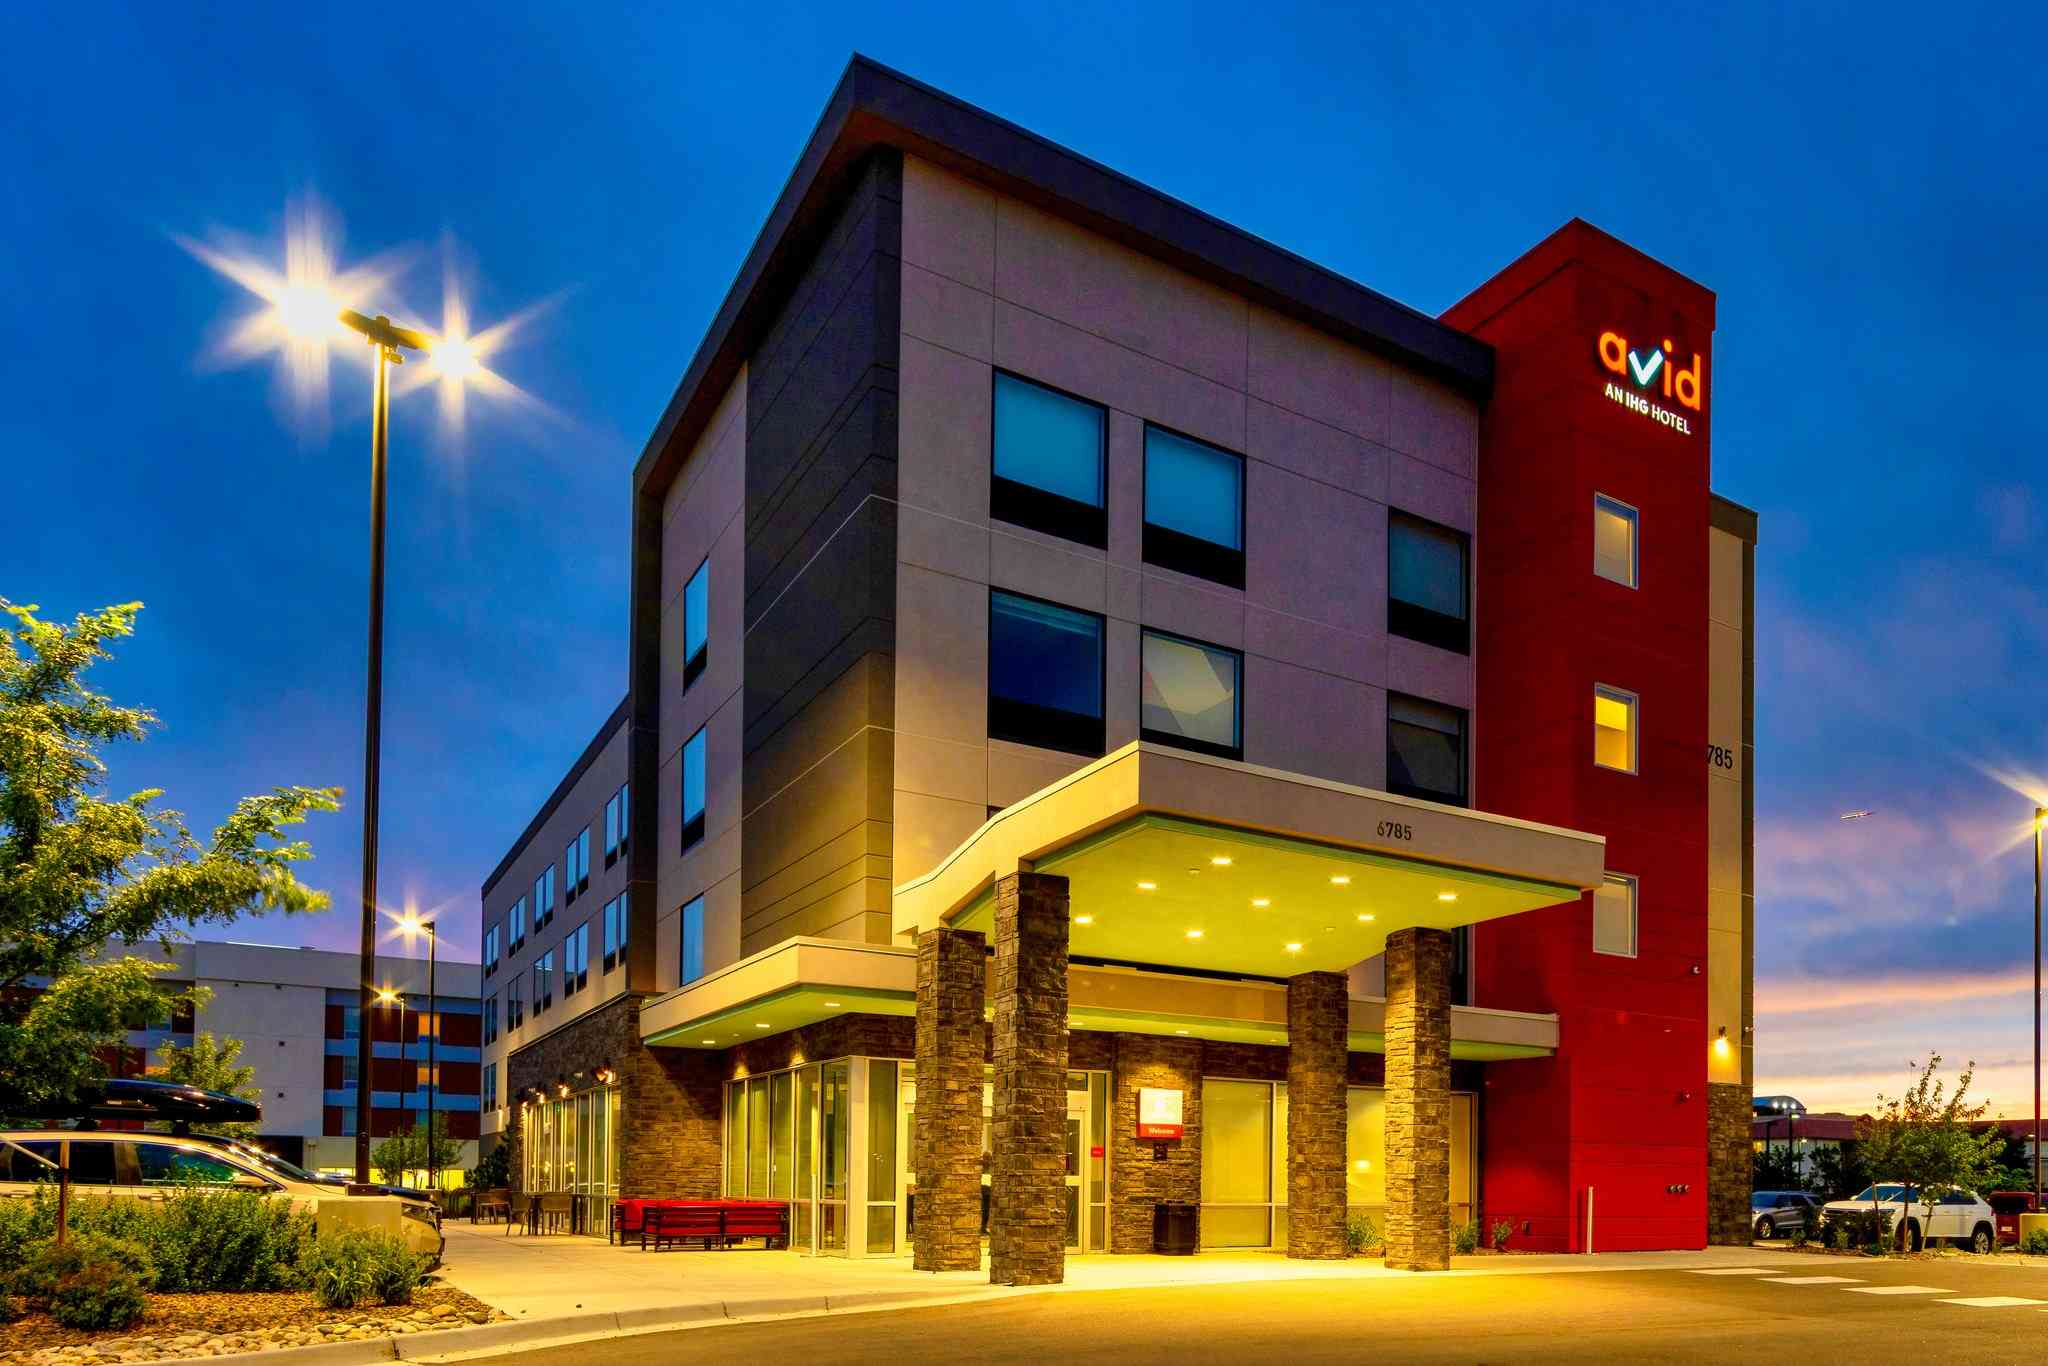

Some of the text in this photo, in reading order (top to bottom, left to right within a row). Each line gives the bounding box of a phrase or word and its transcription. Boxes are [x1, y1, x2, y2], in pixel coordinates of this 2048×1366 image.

[1599, 331, 1700, 411] avid
[1605, 383, 1691, 435] AN IHG HOTEL
[1706, 744, 1733, 769] 785
[1377, 821, 1412, 841] 6785
